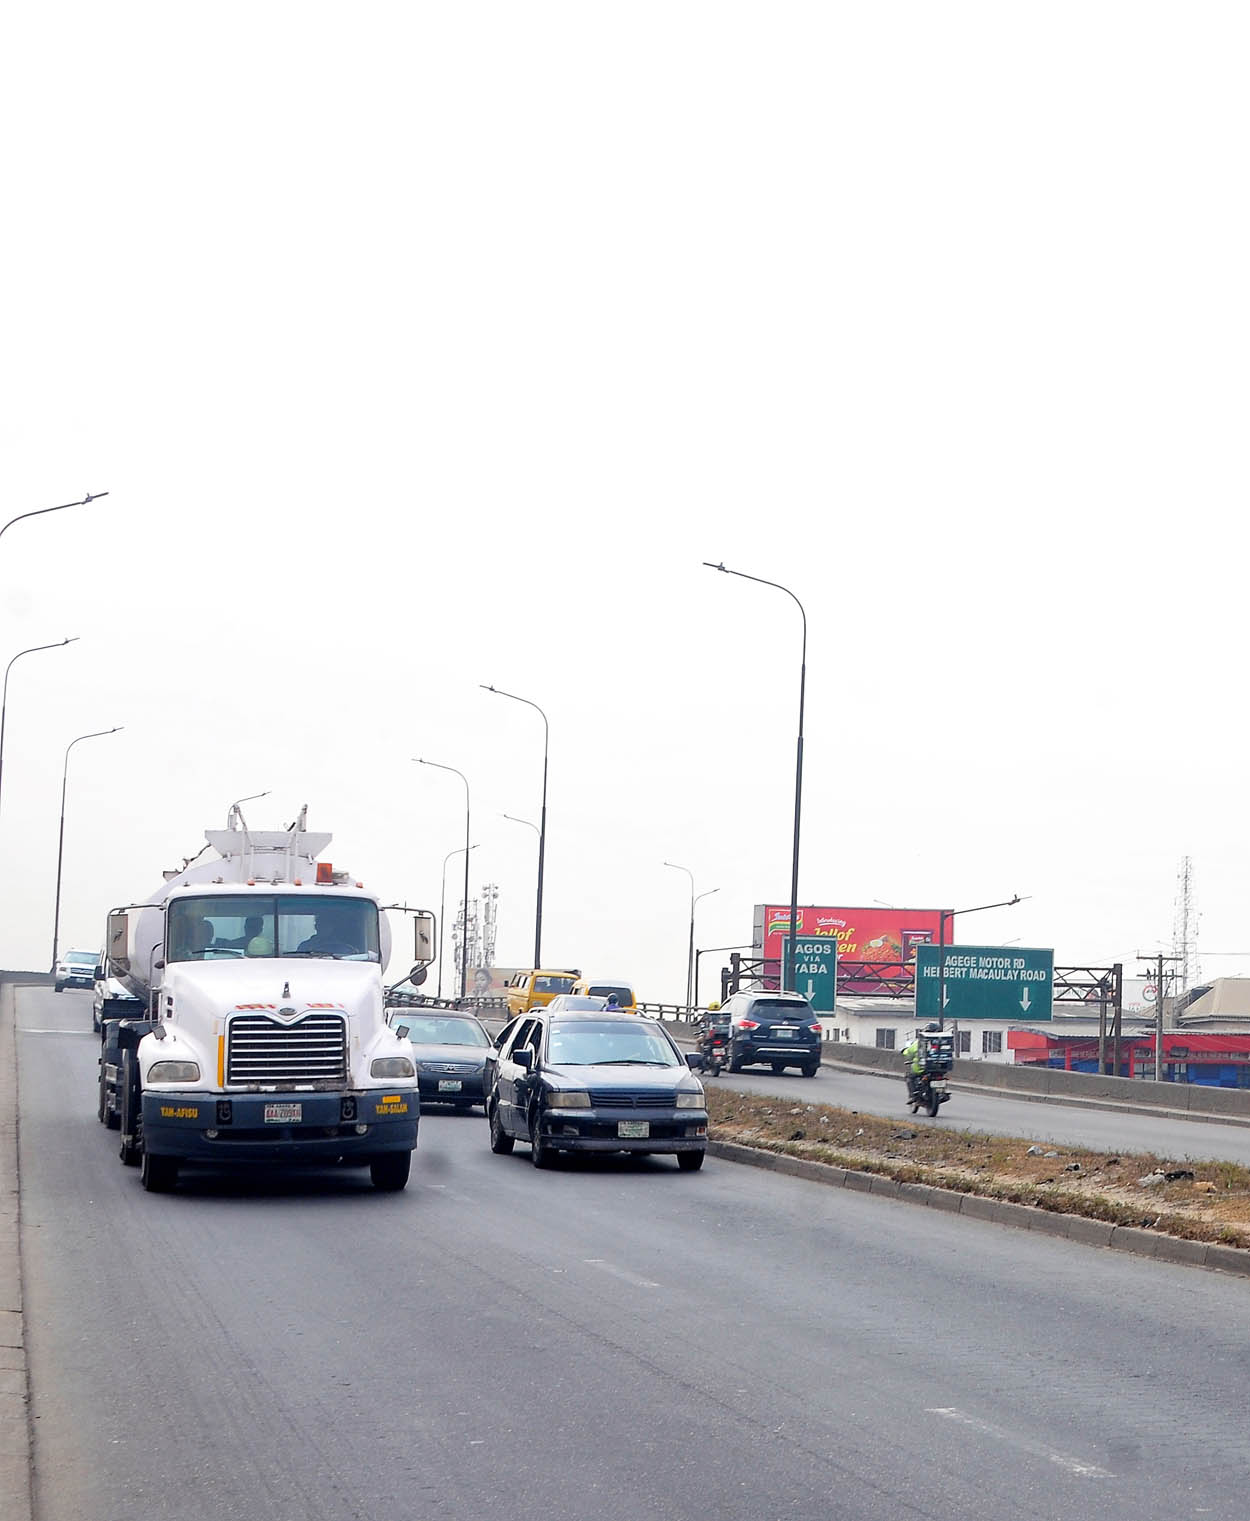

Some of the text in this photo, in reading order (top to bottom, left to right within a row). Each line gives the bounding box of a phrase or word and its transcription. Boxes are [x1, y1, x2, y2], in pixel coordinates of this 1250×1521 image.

[944, 955, 1025, 969] AGEGE MOTOR RD
[969, 968, 1018, 980] MACAULAY
[1020, 969, 1046, 981] ROAD
